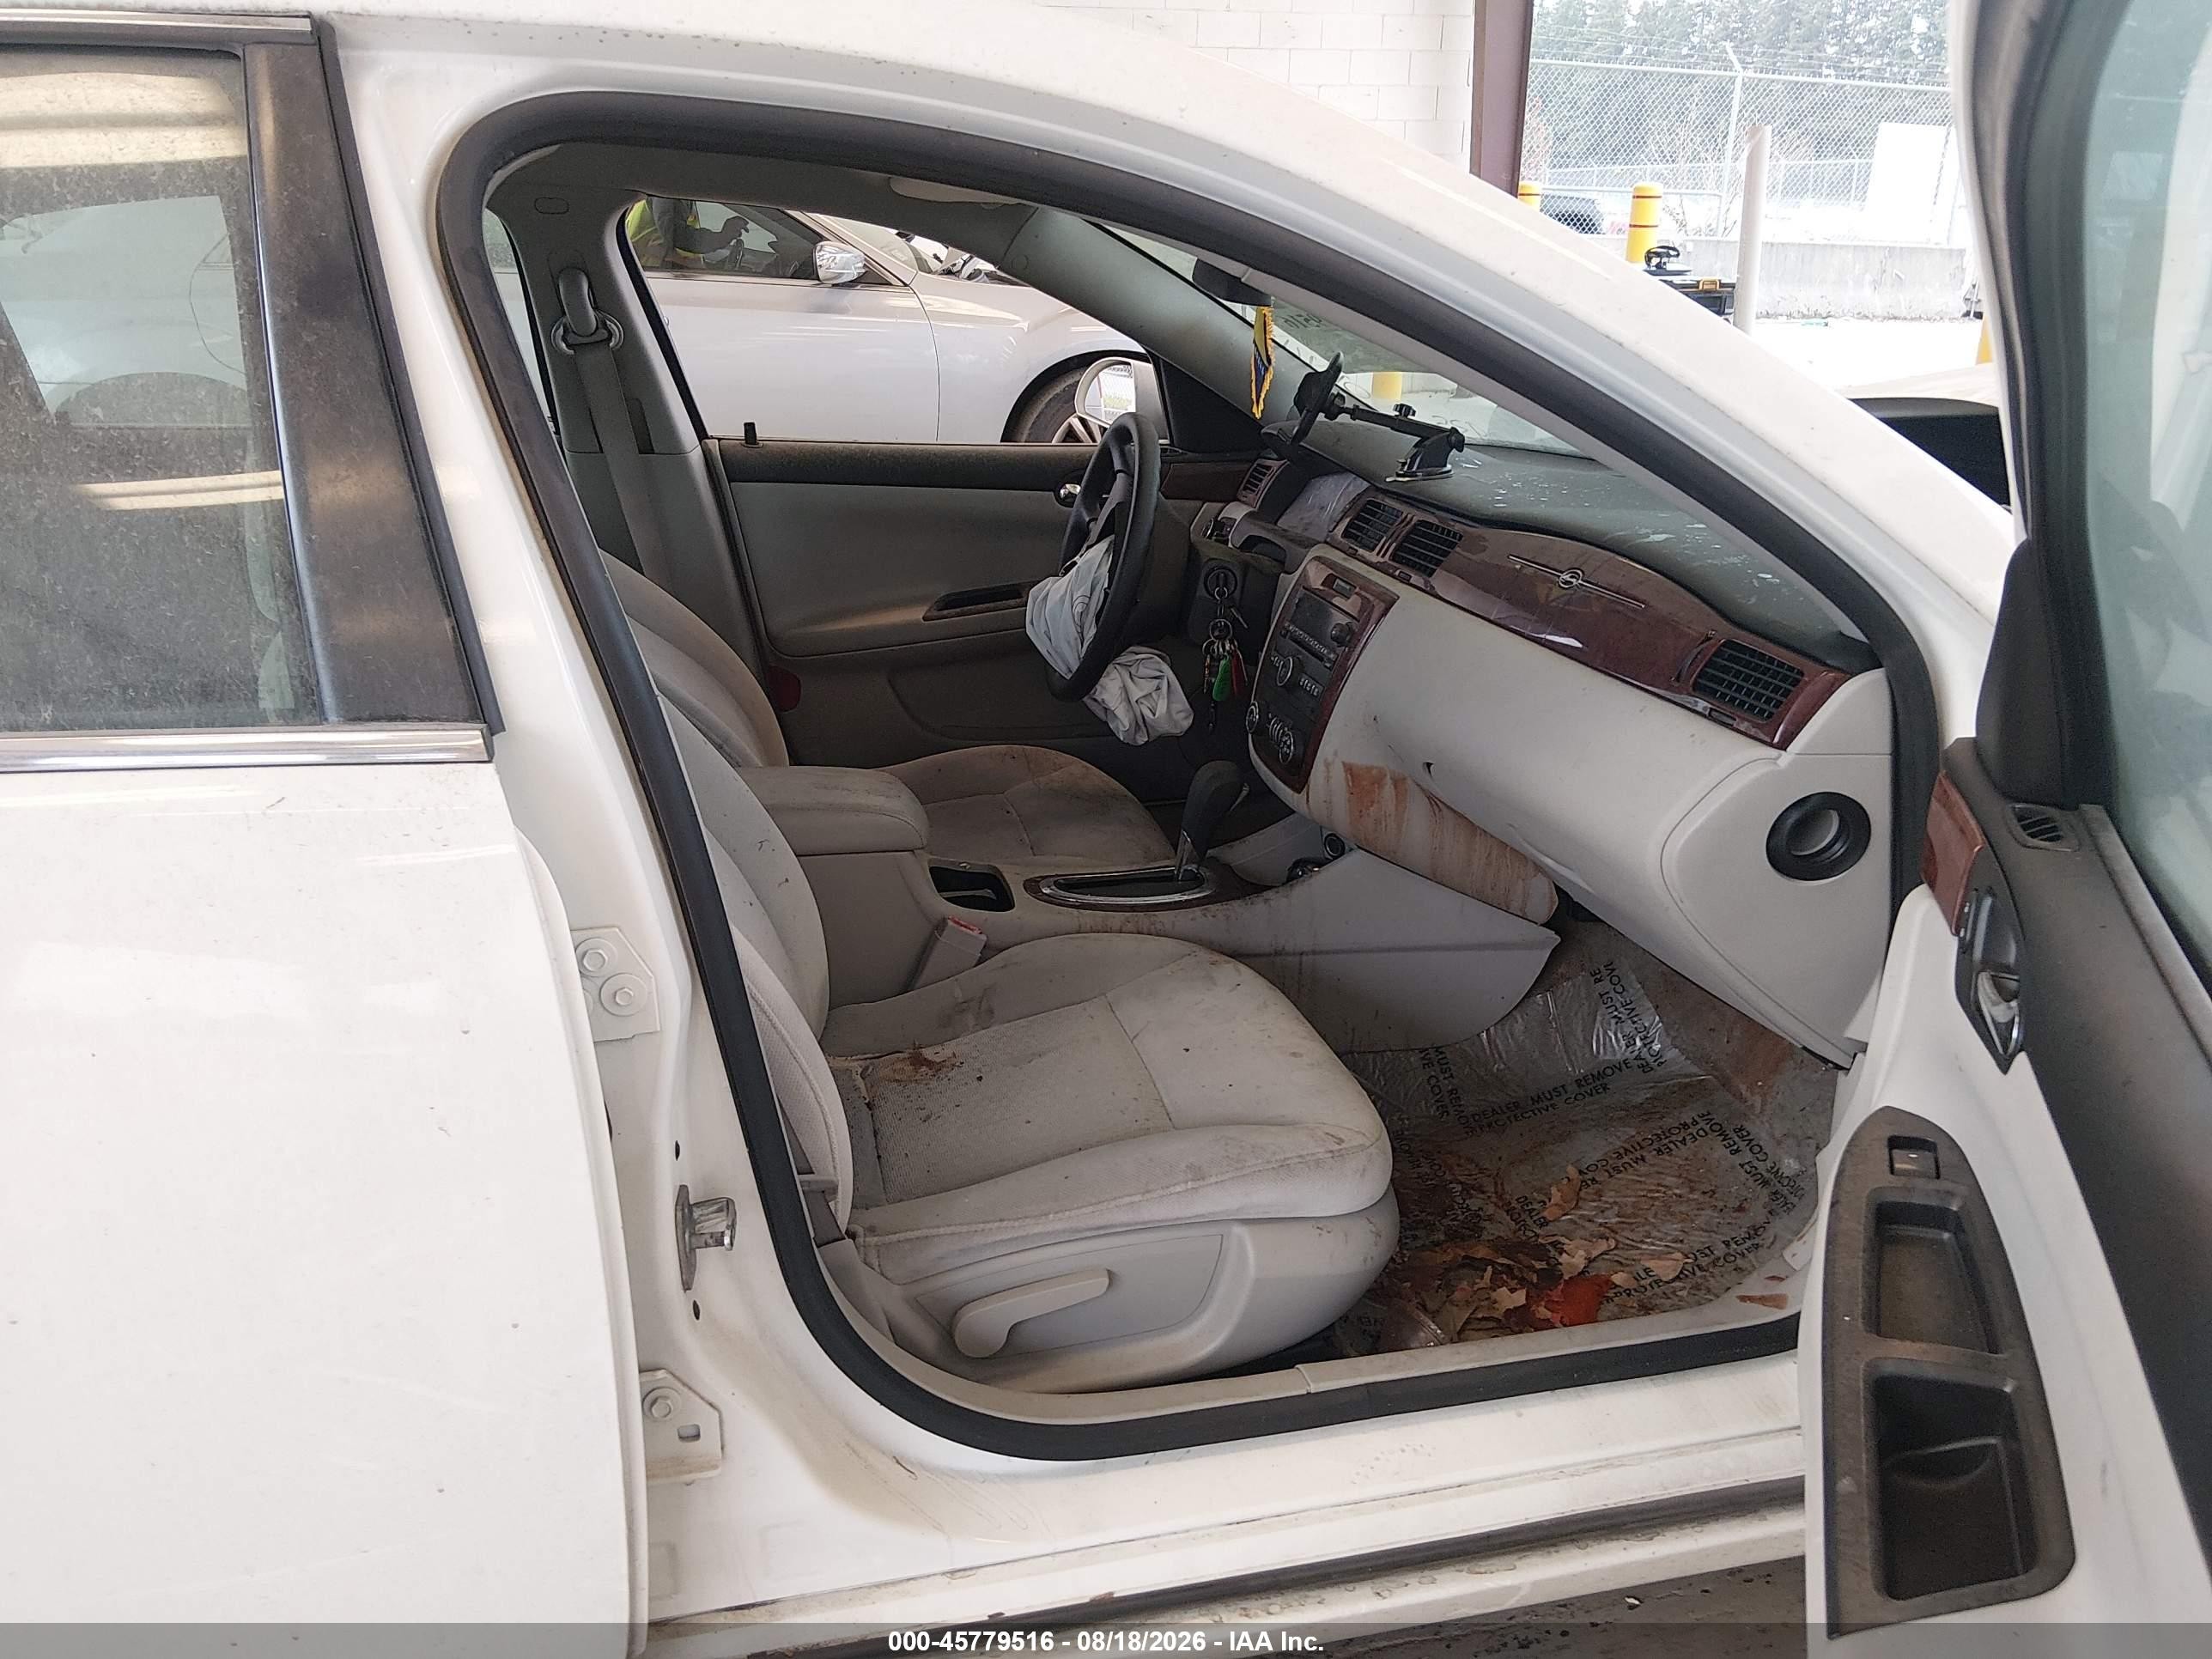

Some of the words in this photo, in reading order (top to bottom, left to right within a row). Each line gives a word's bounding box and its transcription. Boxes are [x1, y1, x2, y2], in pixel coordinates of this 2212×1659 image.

[1472, 1100, 1521, 1123] DEALER
[1530, 1084, 1570, 1106] MUST
[1574, 1058, 1633, 1088] REMOVE
[1565, 1082, 1611, 1106] COVER
[1613, 1115, 1699, 1159] PROTECTIVE
[1652, 1127, 1709, 1156] DEALER
[1698, 1111, 1742, 1156] REMOVE
[1733, 1125, 1768, 1162] COVER
[1606, 1154, 1648, 1179] MUST
